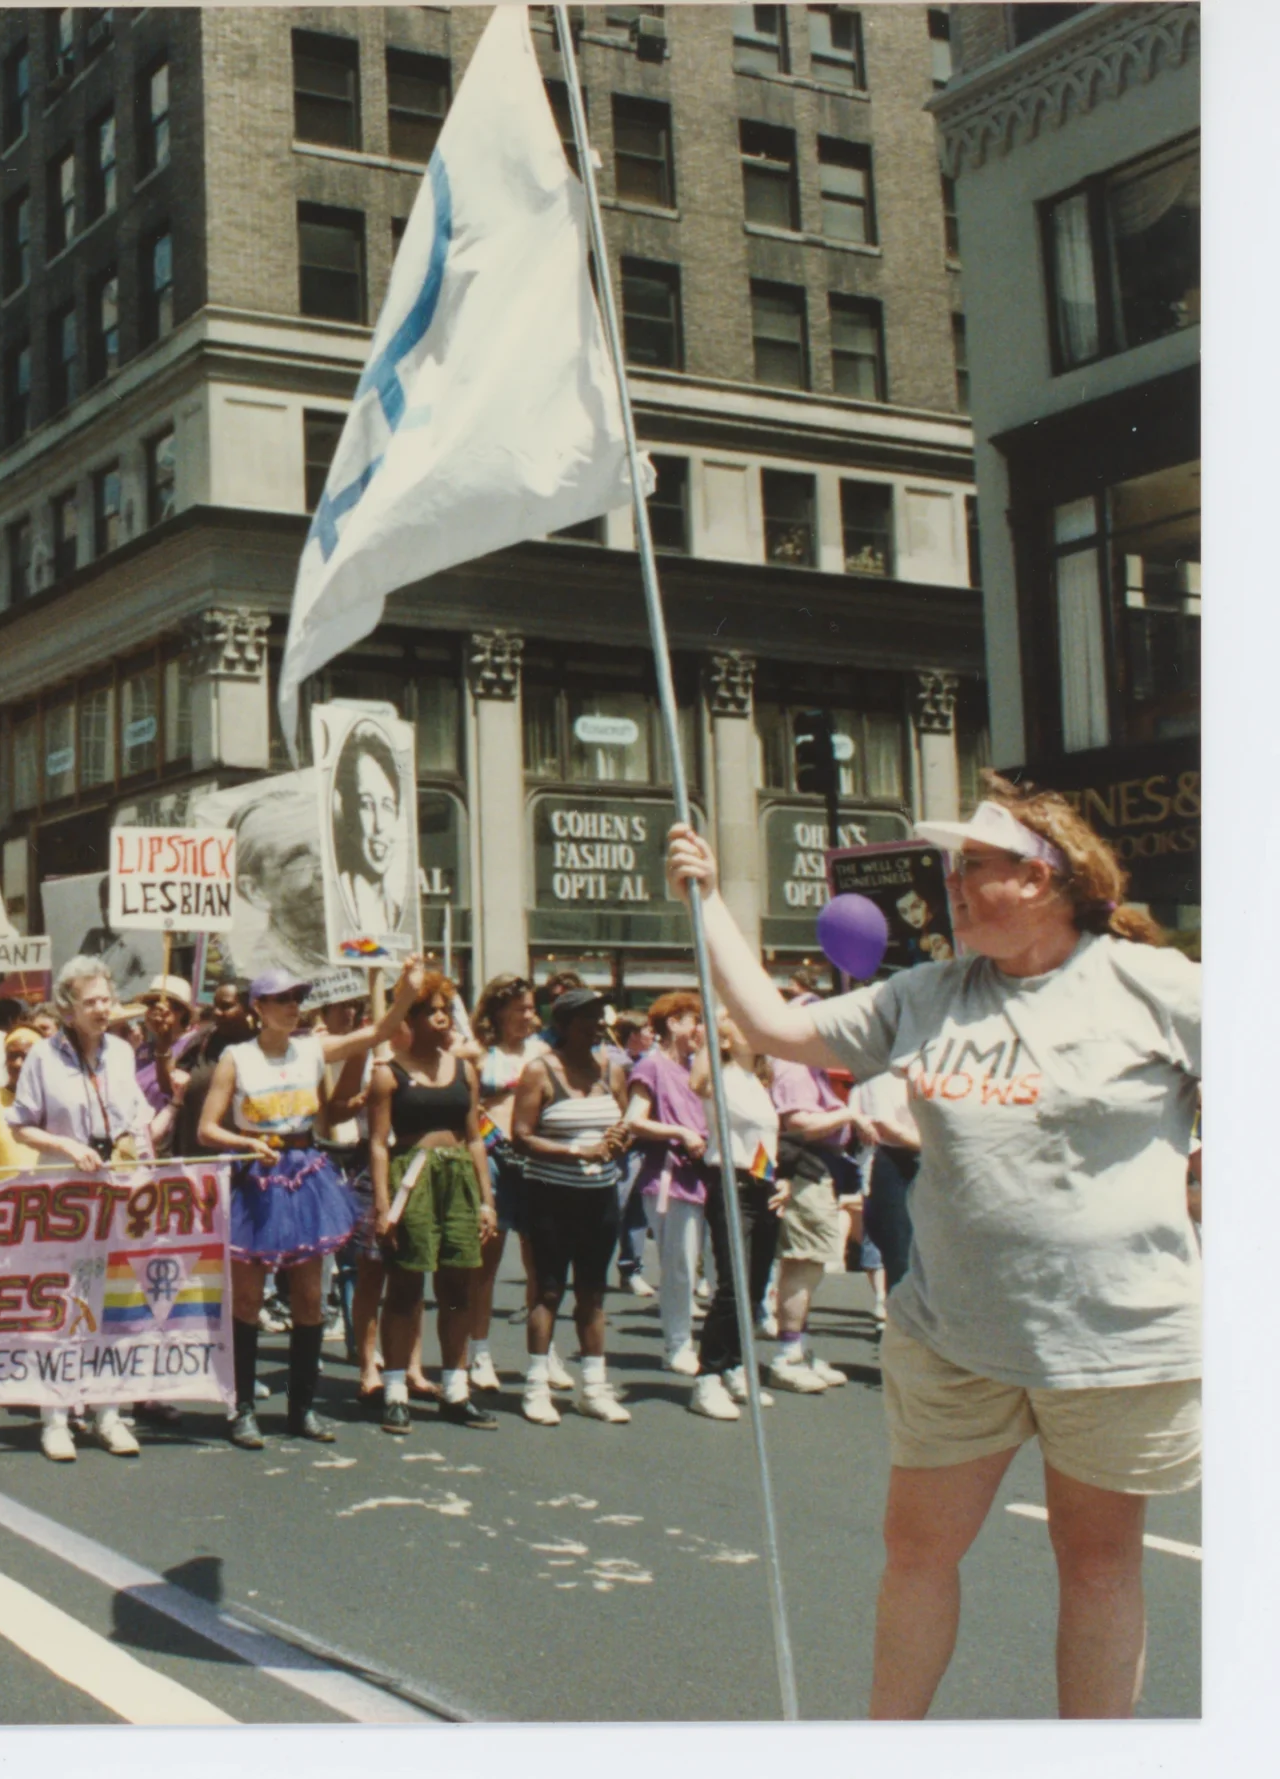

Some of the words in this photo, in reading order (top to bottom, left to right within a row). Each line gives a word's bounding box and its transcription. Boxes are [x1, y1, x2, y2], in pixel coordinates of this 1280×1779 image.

[117, 835, 235, 878] LIPSTICK
[554, 841, 634, 871] FASHIO
[1112, 827, 1198, 861] OOKS
[122, 881, 231, 917] LESBIAN
[79, 1343, 146, 1378] HAVE
